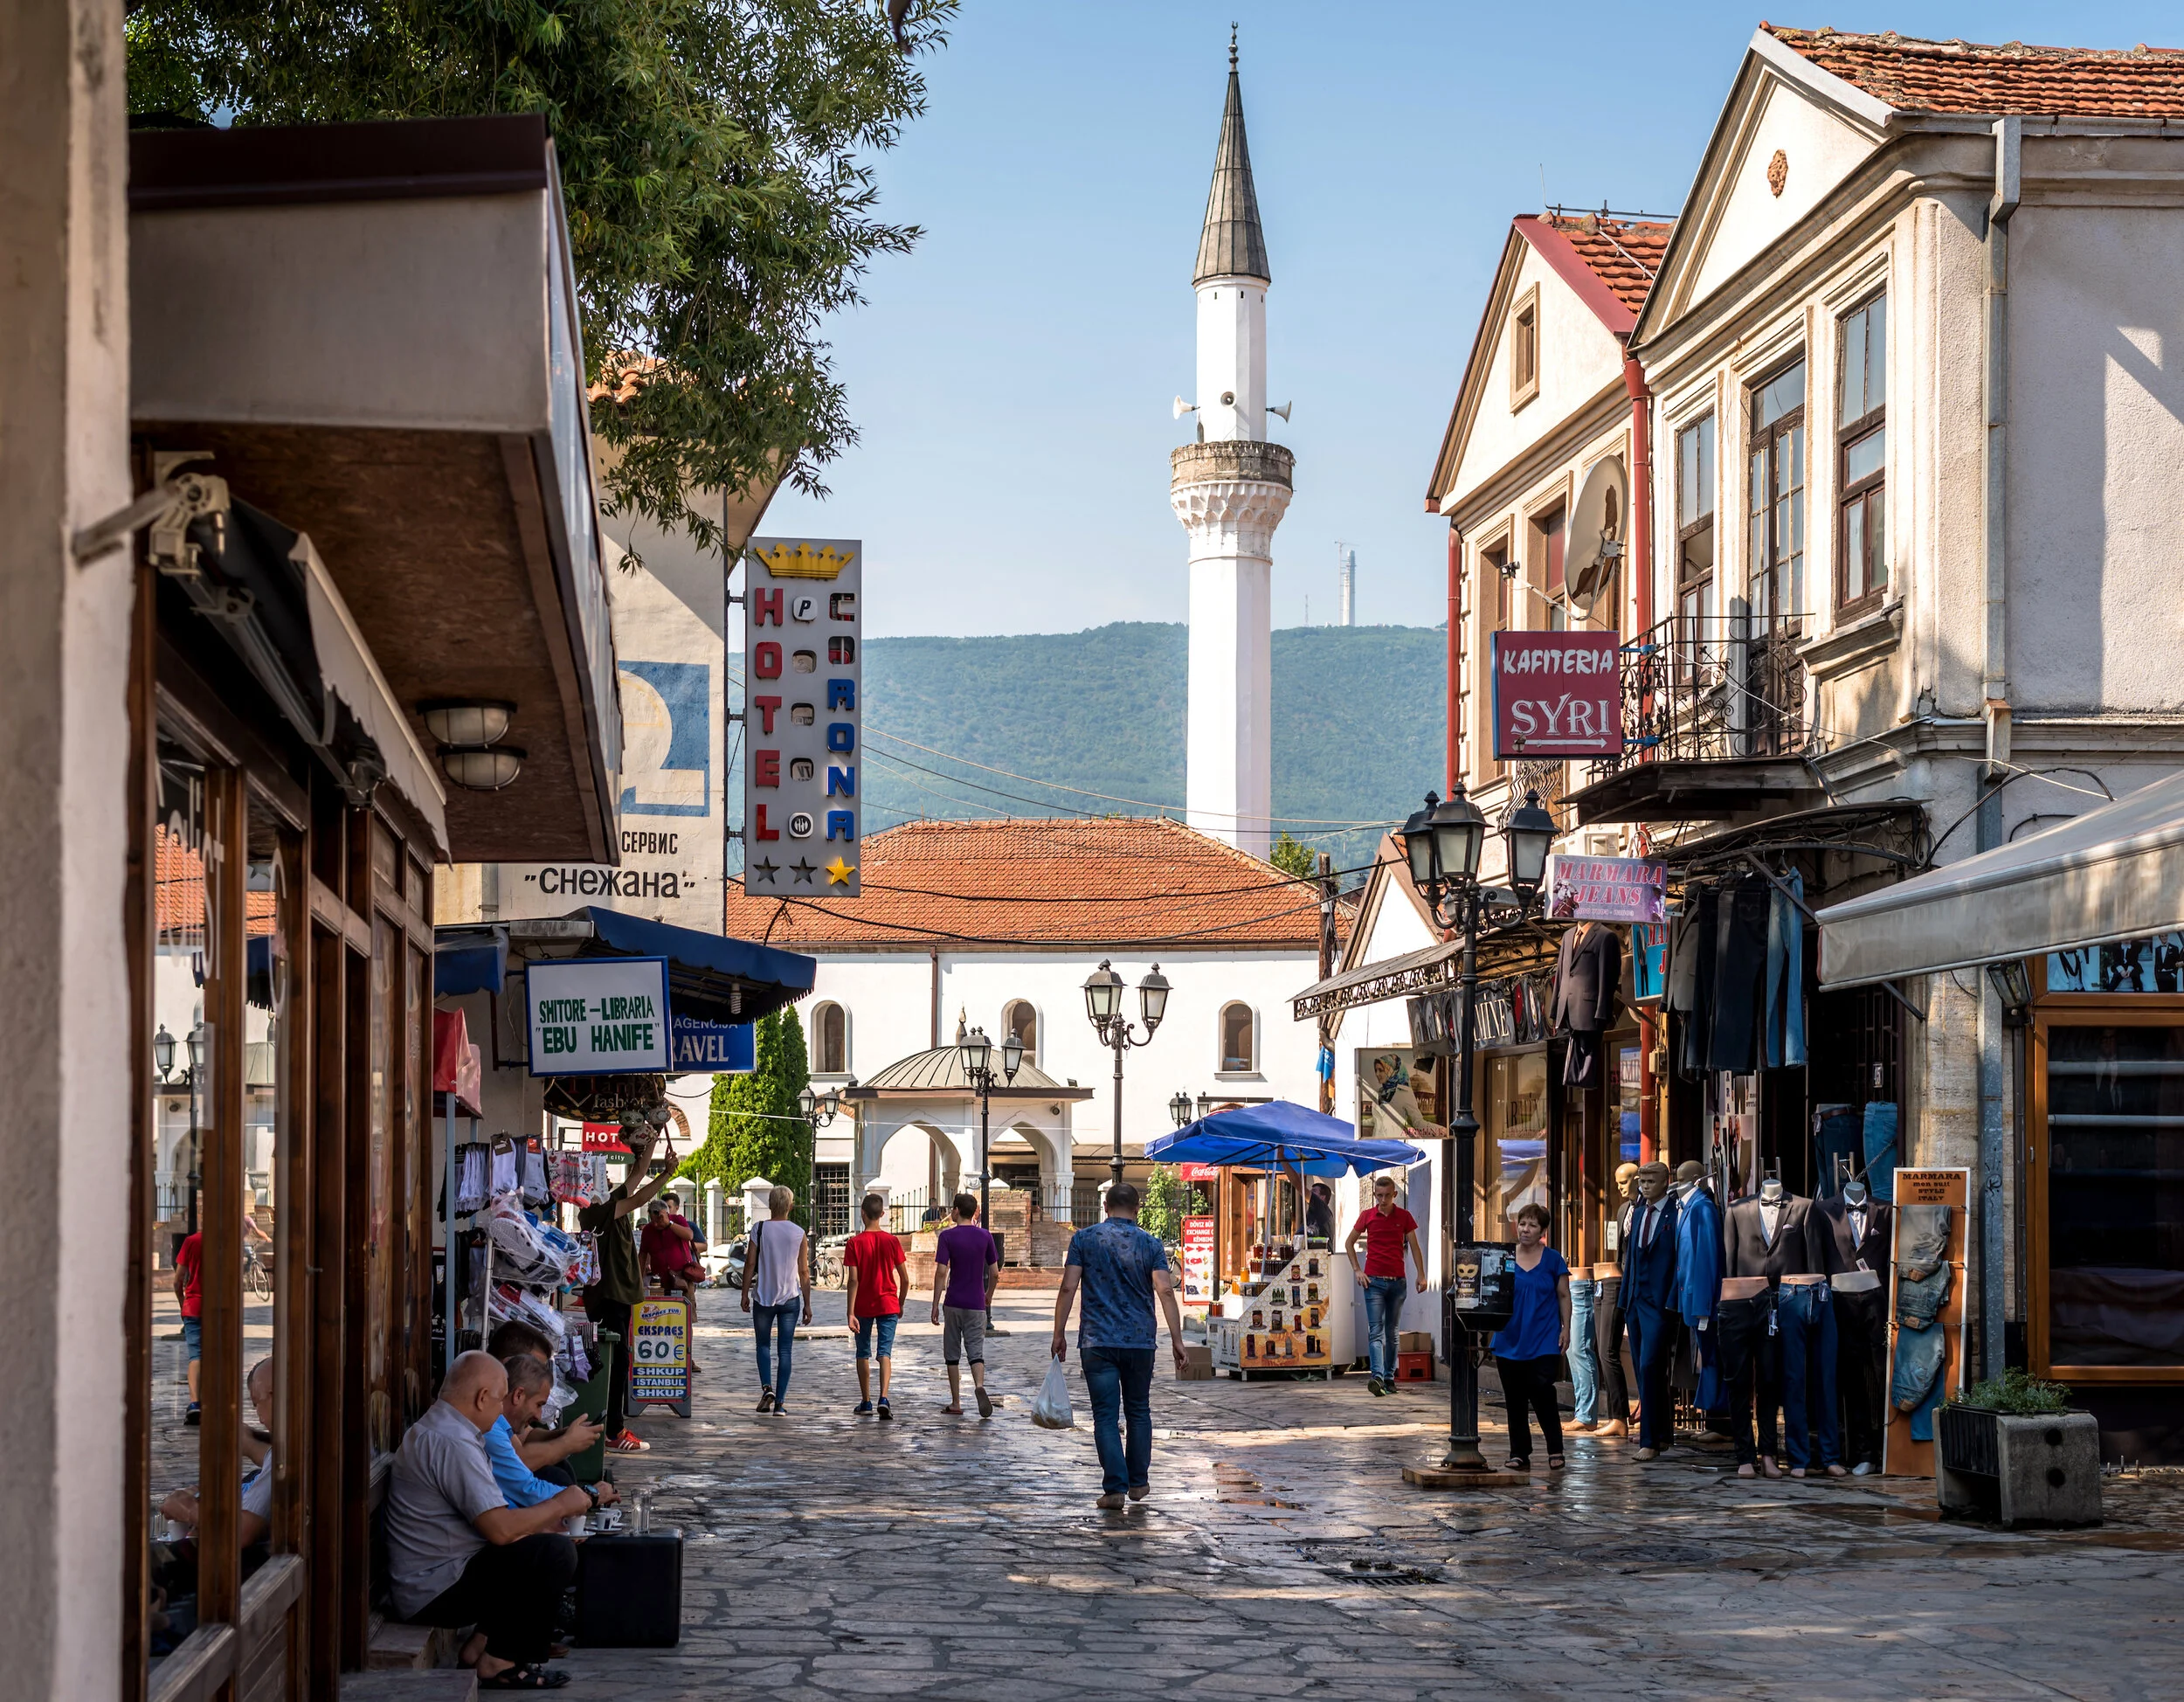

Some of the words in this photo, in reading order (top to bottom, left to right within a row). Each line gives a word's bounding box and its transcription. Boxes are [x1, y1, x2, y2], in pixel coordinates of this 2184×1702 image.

[1503, 649, 1614, 675] KAFITERIA
[755, 588, 783, 841] HOTEL
[621, 831, 678, 854] СЕРВИС
[1556, 861, 1663, 885] MARMARA
[1573, 884, 1642, 906] JEANS
[539, 999, 585, 1024] SHITORE
[585, 1131, 619, 1144] HOT
[638, 1325, 683, 1336] EKSPRES
[638, 1340, 669, 1359] 60
